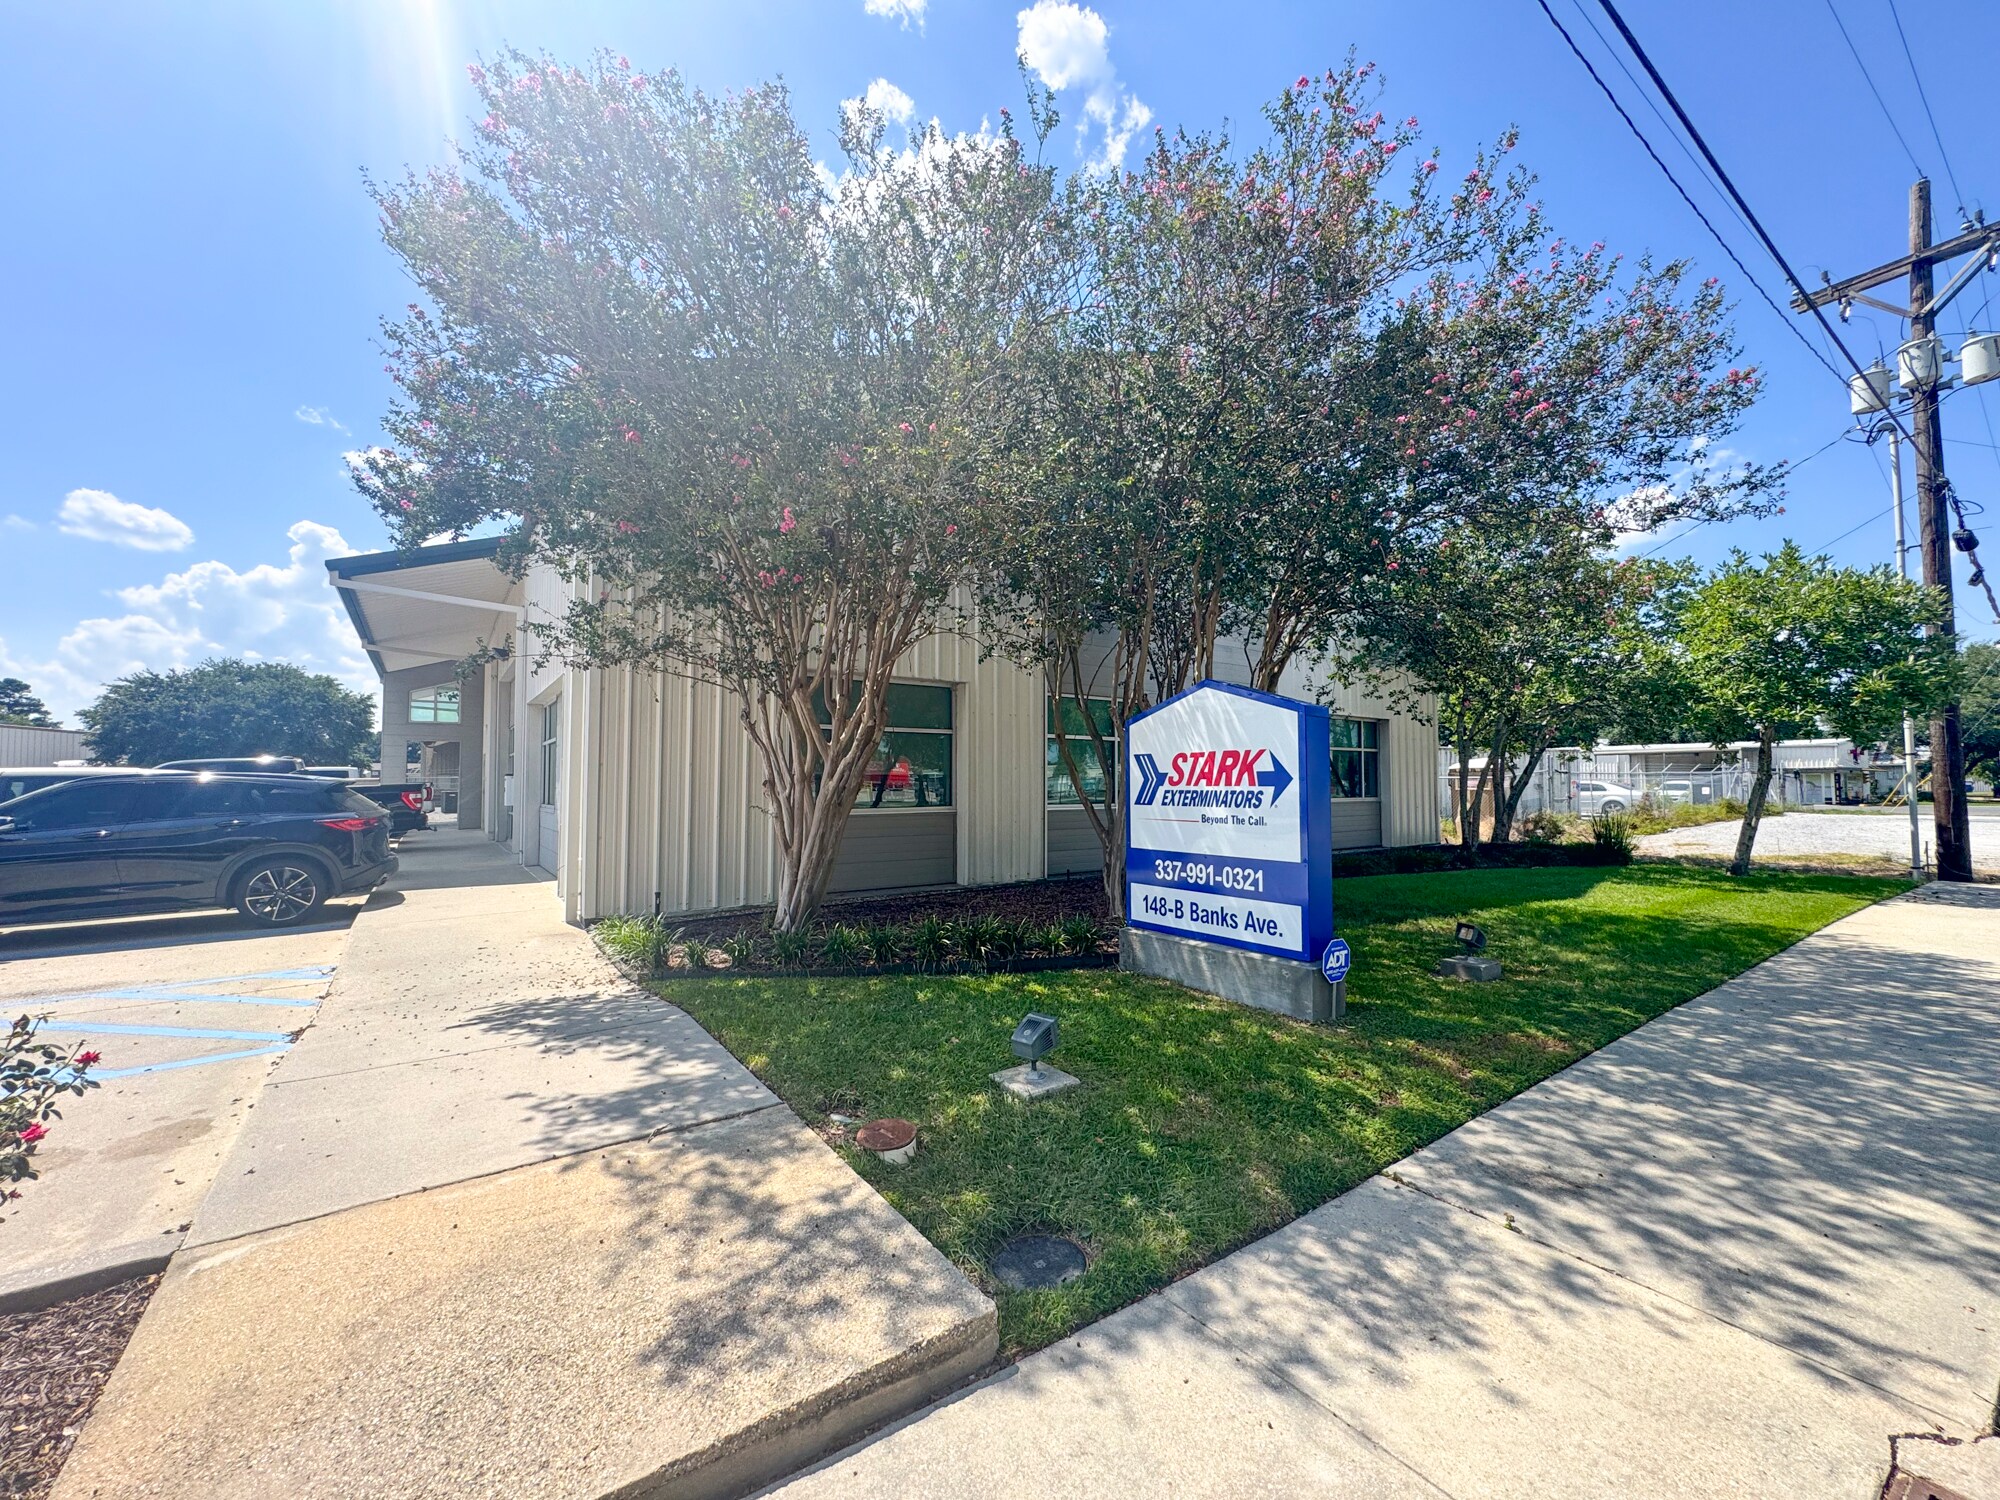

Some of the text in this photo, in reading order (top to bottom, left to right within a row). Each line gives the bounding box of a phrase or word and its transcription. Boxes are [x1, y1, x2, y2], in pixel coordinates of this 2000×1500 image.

[1168, 748, 1267, 787] STARK
[1160, 789, 1264, 809] EXTERMINATORS
[1201, 813, 1228, 825] Beyond
[1231, 815, 1246, 825] The
[1155, 859, 1264, 893] 337-991-0321
[1142, 894, 1283, 938] 148-B Banks Ave.
[1326, 949, 1348, 970] ADT
